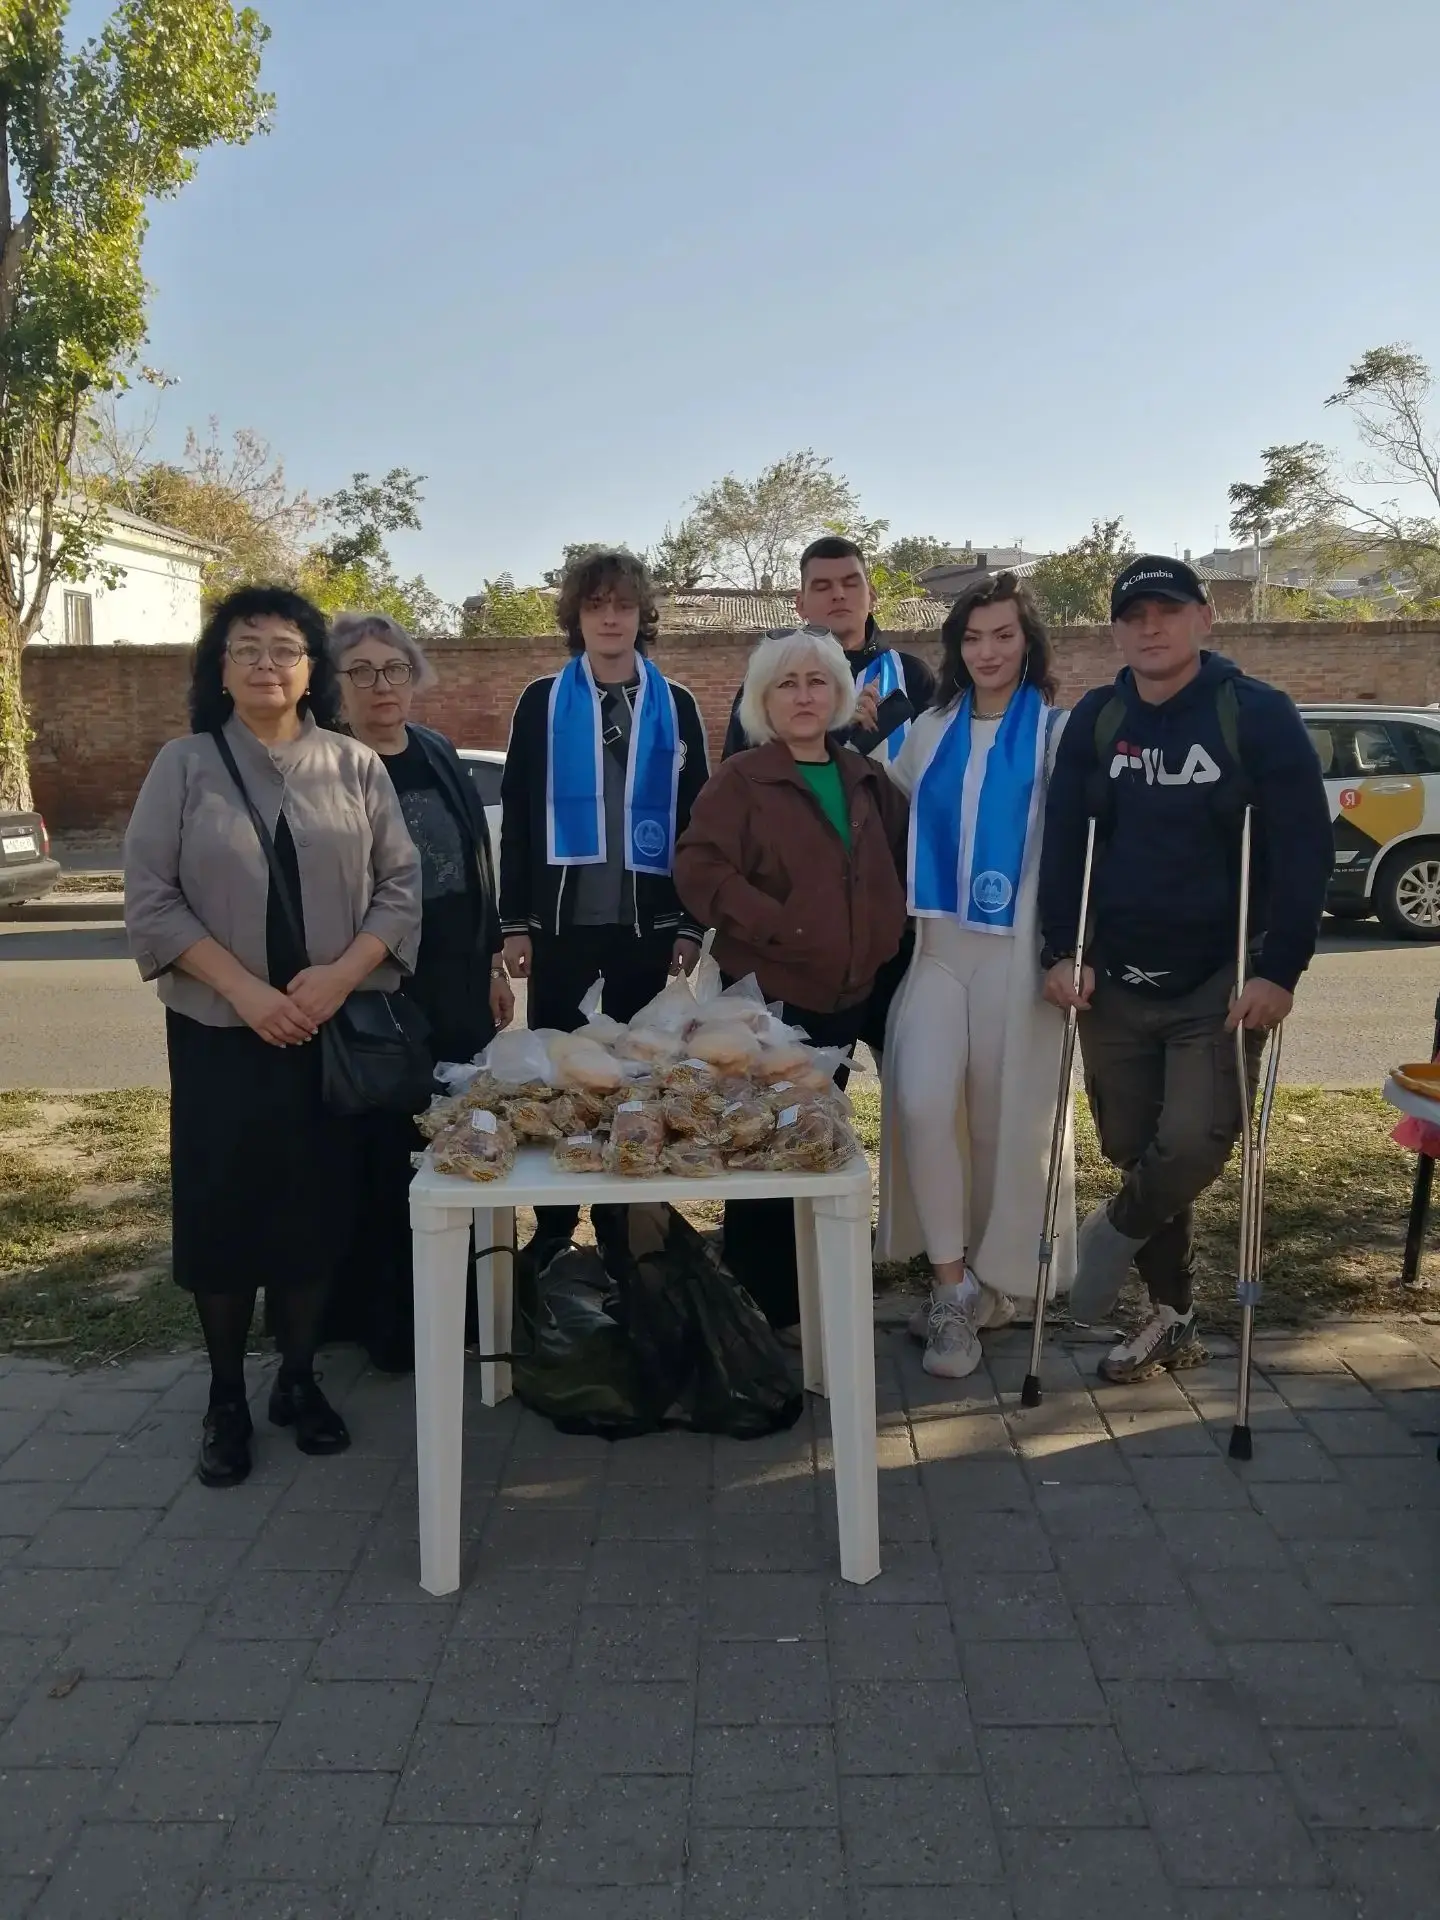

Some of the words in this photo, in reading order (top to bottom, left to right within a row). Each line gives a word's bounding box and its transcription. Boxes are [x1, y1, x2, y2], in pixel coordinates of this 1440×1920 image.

[1129, 570, 1173, 585] Columbia
[1109, 741, 1221, 785] FILA
[1345, 791, 1355, 806] Я
